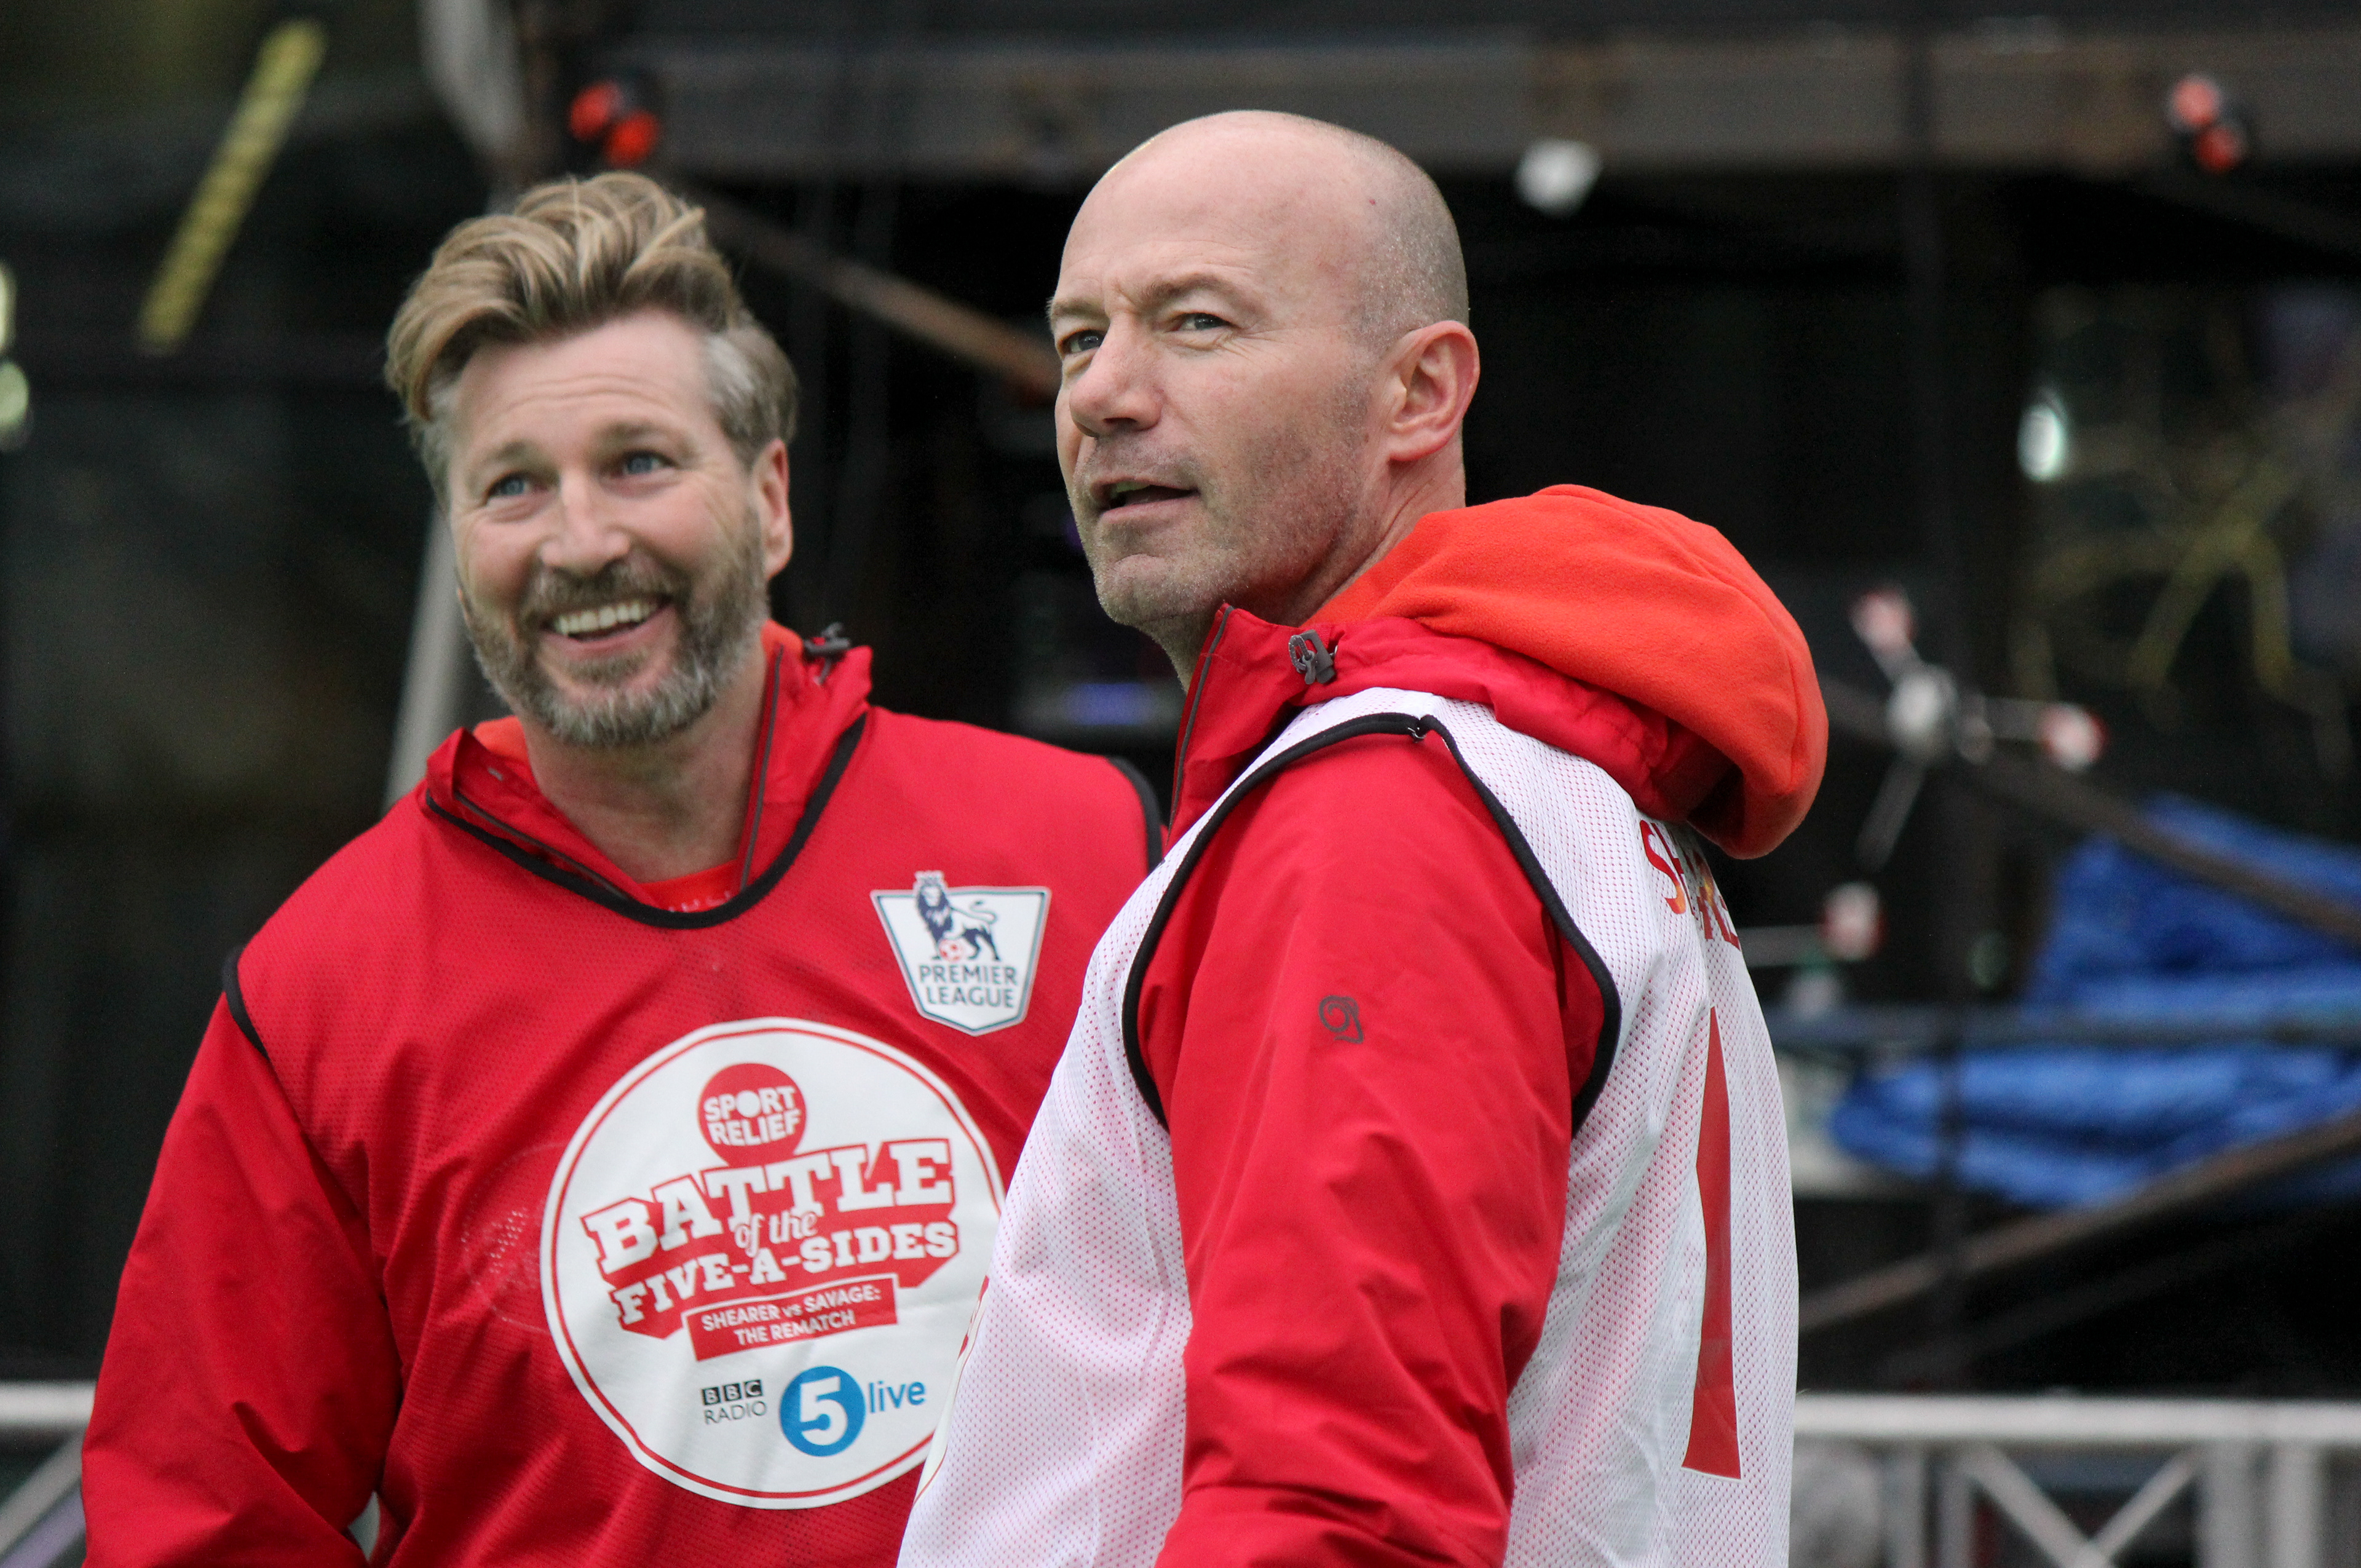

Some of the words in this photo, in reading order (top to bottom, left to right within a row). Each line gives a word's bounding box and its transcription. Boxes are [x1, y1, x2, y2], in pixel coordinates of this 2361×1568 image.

[919, 965, 1018, 986] PREMIER
[926, 986, 1016, 1008] LEAGUE
[703, 1085, 796, 1122] SPORT
[707, 1109, 801, 1146] RELIEF
[584, 1139, 953, 1275] BATTLE
[734, 1212, 763, 1257] of
[769, 1208, 818, 1244] the
[612, 1221, 958, 1326] FIVE-A-SIDES
[701, 1304, 781, 1331] SHEARER
[781, 1304, 803, 1318] vs
[803, 1284, 882, 1313] SAVAGE:
[734, 1325, 769, 1345] THE
[769, 1308, 856, 1340] REMATCH
[702, 1379, 764, 1406] BBC
[799, 1376, 848, 1446] 5
[868, 1380, 927, 1414] live
[703, 1401, 767, 1425] RADIO
